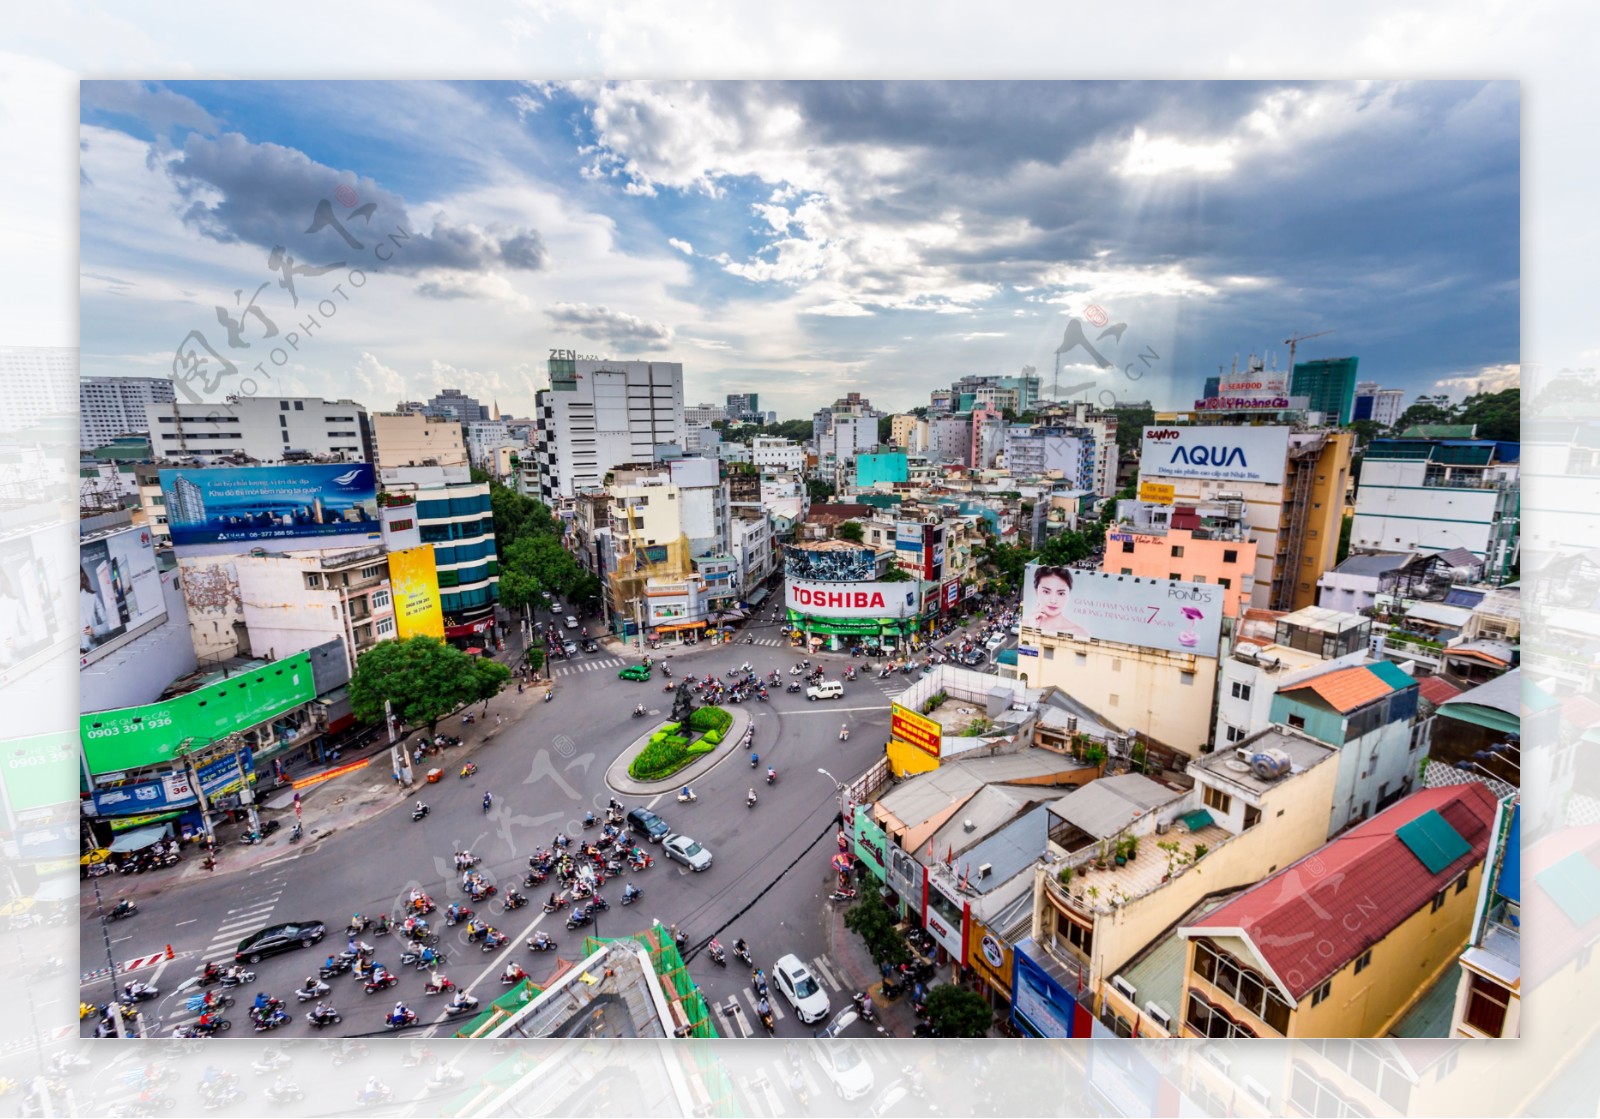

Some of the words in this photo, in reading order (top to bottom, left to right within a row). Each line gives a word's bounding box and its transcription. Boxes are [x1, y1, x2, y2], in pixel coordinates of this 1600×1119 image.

[549, 349, 576, 361] ZEN
[1228, 382, 1262, 392] SEAFOOD
[1146, 429, 1180, 440] SANYO
[1170, 445, 1247, 467] AQUA
[1110, 534, 1133, 542] HOTEL
[792, 585, 885, 608] TOSHIBA
[1168, 589, 1212, 603] POND'S
[1147, 606, 1160, 624] 7
[87, 727, 120, 740] 0903
[123, 723, 146, 735] 391
[149, 717, 172, 730] 936
[173, 785, 188, 795] 36
